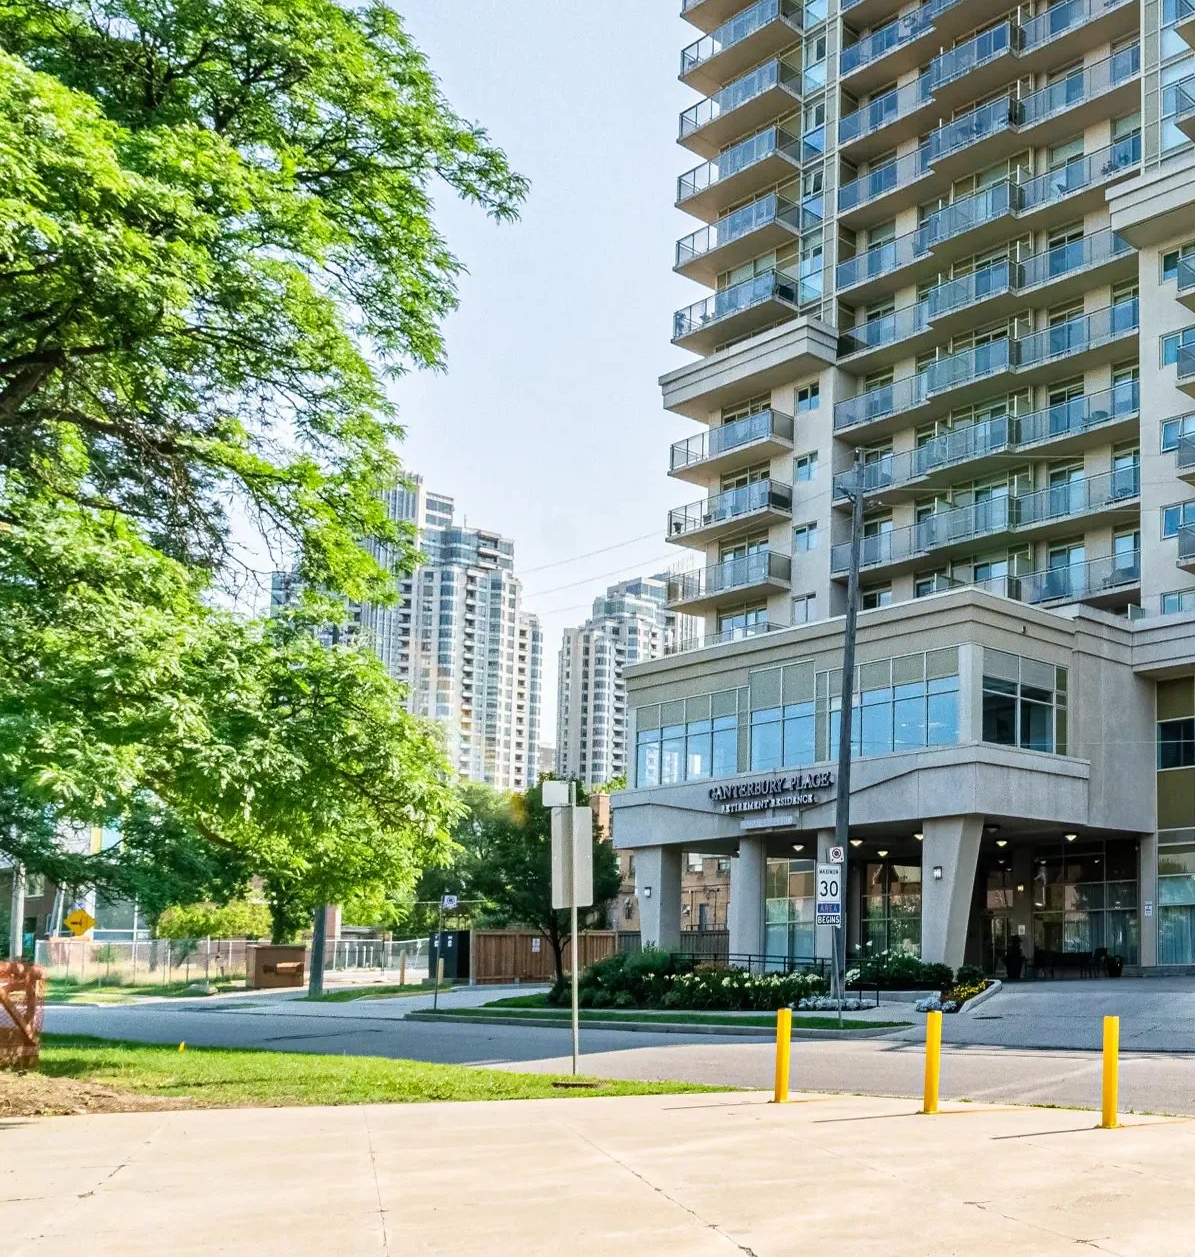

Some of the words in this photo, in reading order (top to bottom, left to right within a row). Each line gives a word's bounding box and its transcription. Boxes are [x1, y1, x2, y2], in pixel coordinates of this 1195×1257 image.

[709, 778, 787, 800] CANTERBURY
[789, 772, 832, 791] PLACE
[721, 799, 769, 813] RETIREMENT
[770, 794, 814, 808] RESIDENCE
[820, 881, 838, 897] 30
[820, 905, 838, 913] AREA
[818, 915, 840, 924] BEGINS
